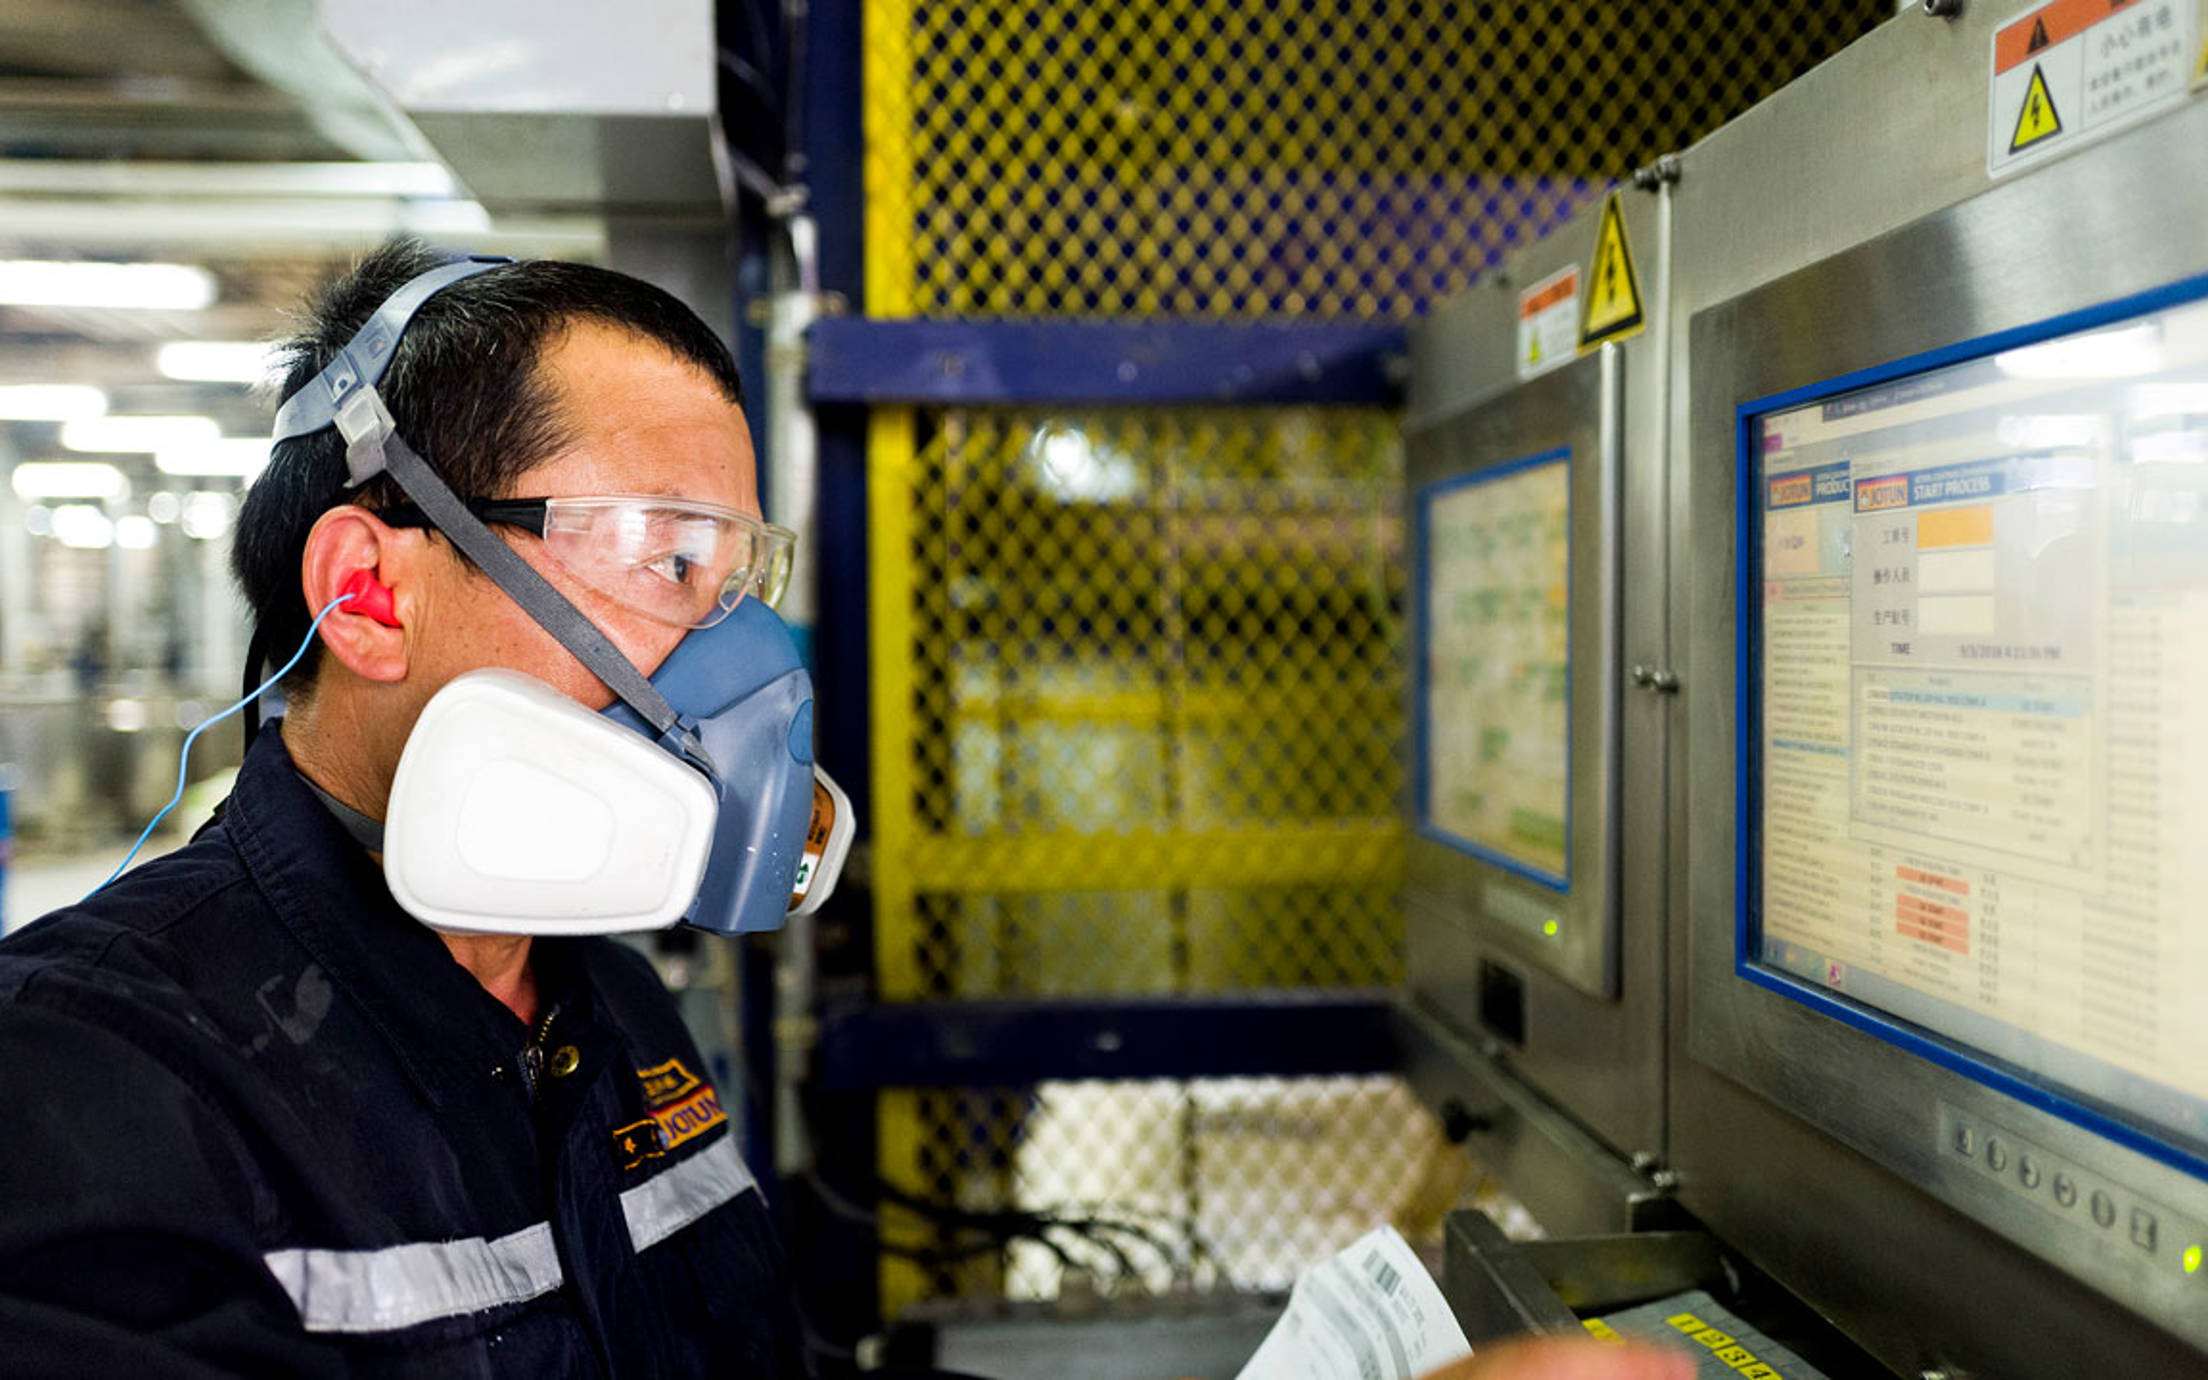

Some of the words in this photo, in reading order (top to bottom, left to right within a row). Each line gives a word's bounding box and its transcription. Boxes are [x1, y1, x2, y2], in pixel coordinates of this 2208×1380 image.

[1913, 482, 1943, 501] START
[1945, 475, 1991, 496] PROCESS
[1891, 642, 1911, 655] TIME
[663, 1096, 722, 1140] JOTUN
[1722, 1350, 1747, 1362] 3
